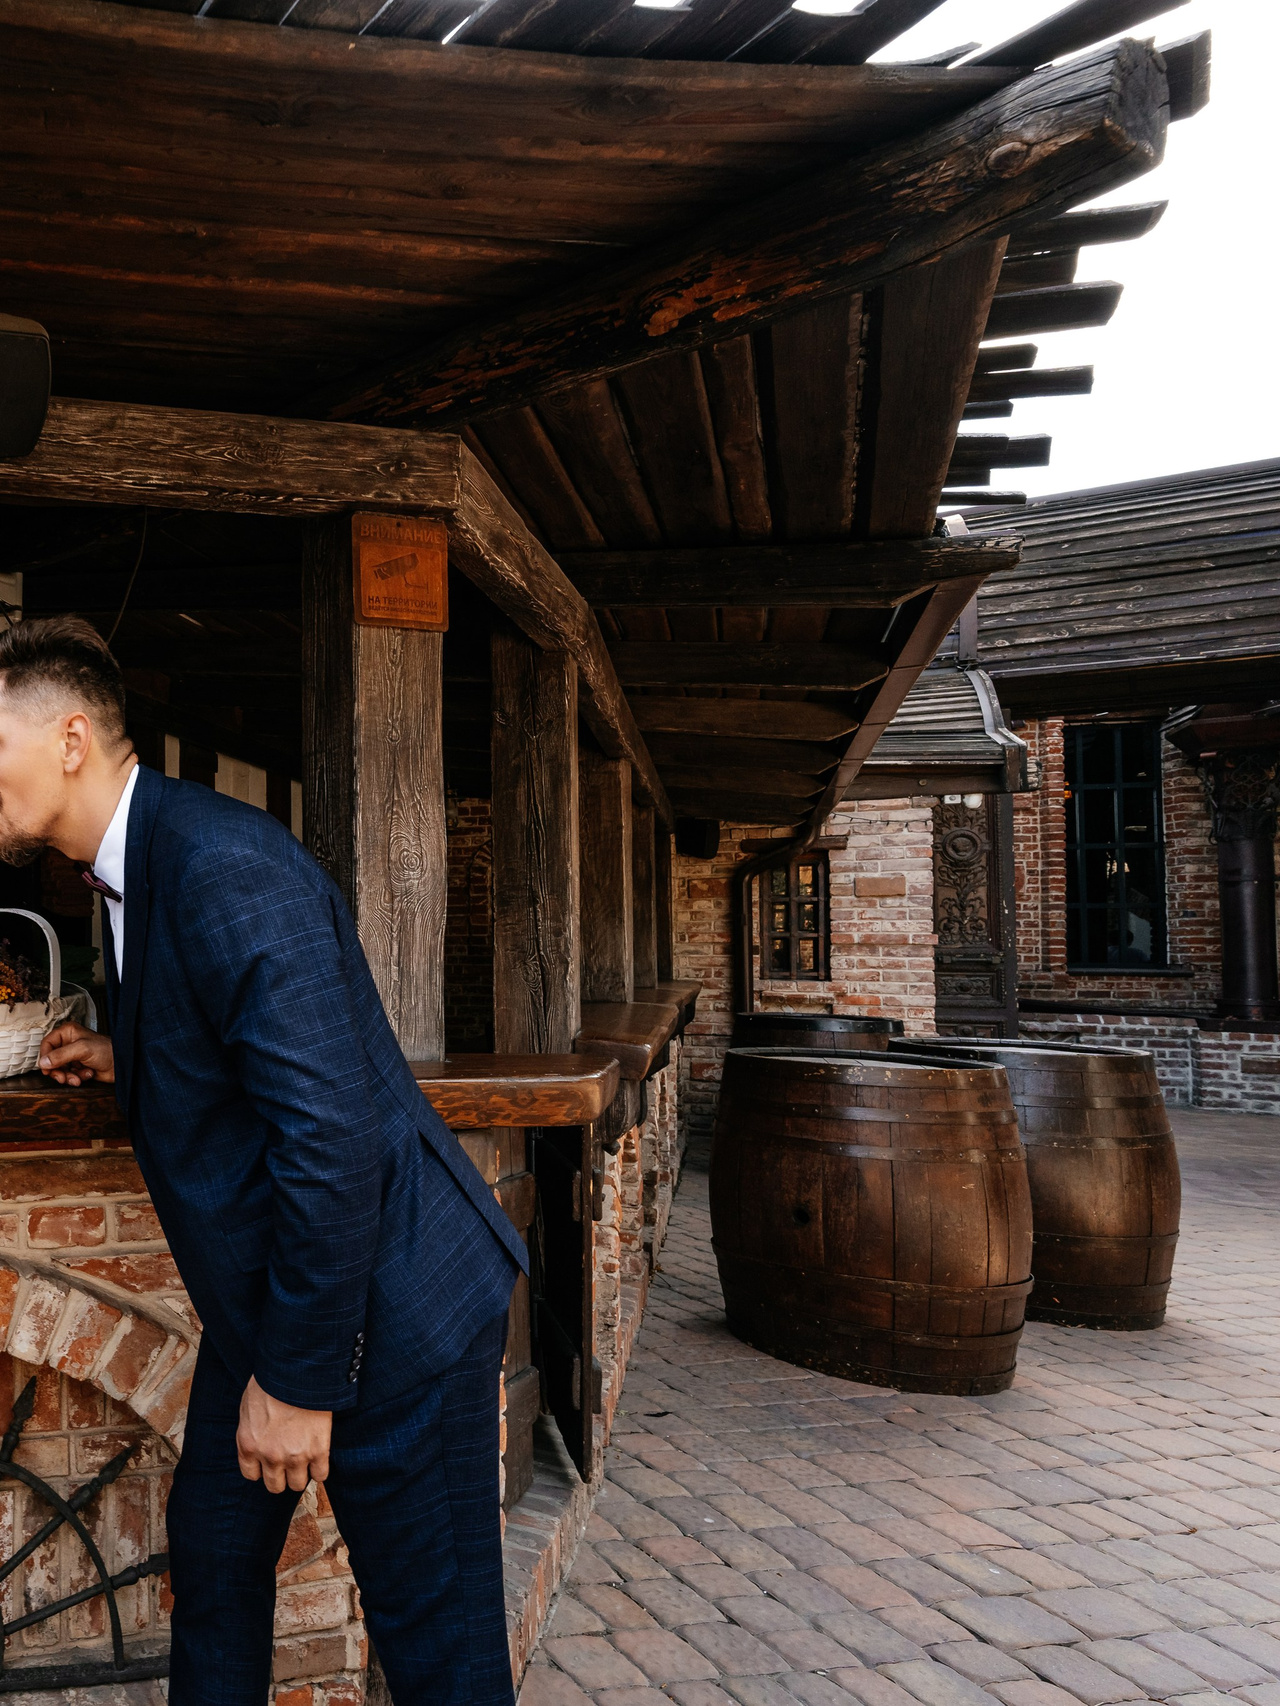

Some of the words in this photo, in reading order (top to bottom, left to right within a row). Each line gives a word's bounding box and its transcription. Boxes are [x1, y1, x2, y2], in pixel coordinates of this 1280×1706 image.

[360, 523, 442, 544] ВНИМАНИЕ
[368, 595, 381, 603] НА
[382, 596, 438, 610] ТЕРРИТОРИИ
